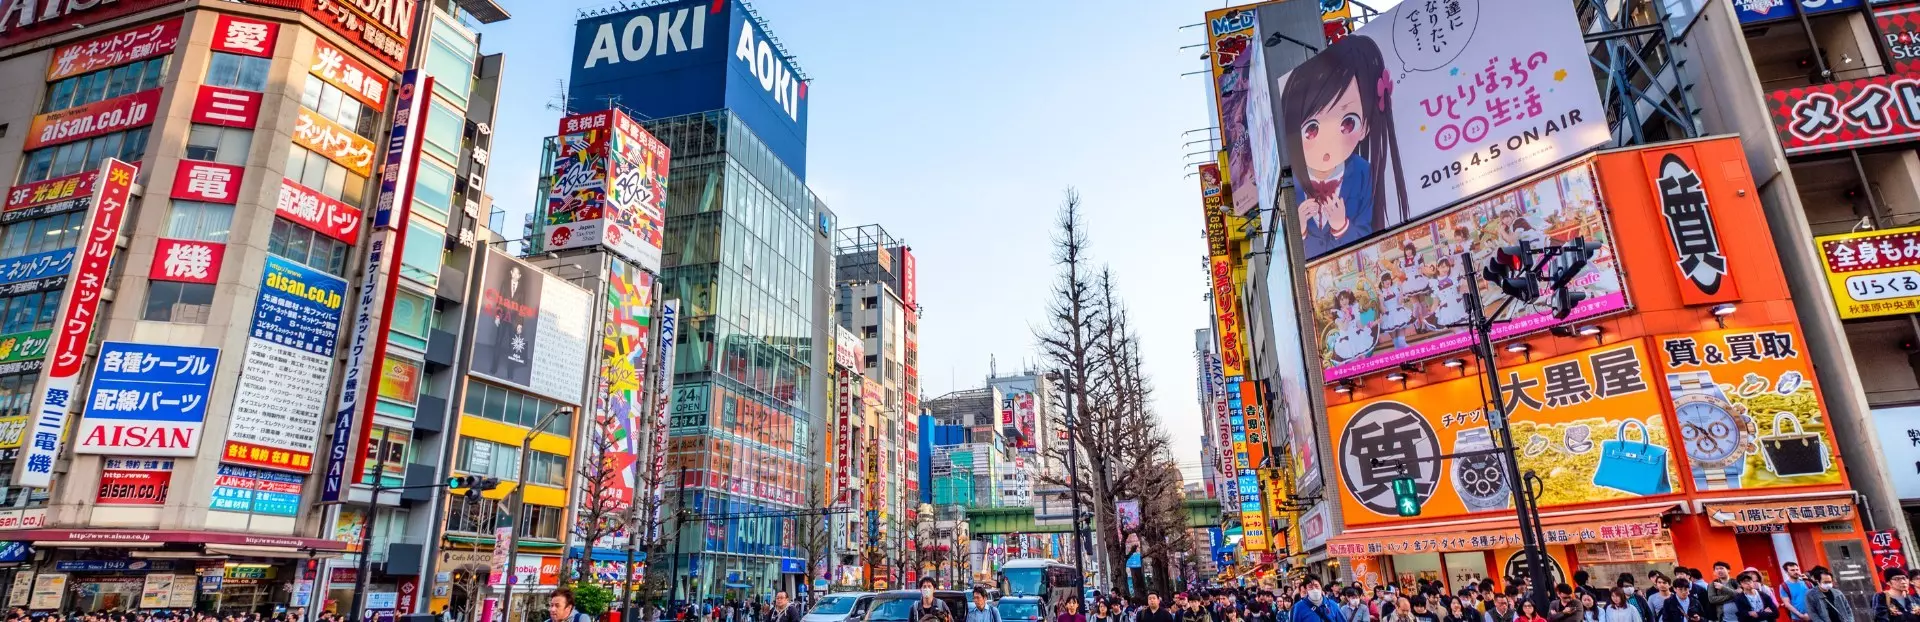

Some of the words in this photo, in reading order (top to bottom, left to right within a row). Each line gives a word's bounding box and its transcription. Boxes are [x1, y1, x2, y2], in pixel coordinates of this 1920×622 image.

[1425, 0, 1447, 52] なりたい
[1443, 0, 1463, 30] 達に
[224, 20, 268, 52] 愛
[584, 6, 706, 68] AOKI
[312, 46, 384, 104] 光通信
[736, 19, 797, 122] AOKI
[1420, 51, 1547, 120] ひとりぼっちの
[40, 101, 148, 143] aisan.co.jp
[205, 92, 249, 122] 三
[567, 114, 606, 131] 免税店
[295, 118, 373, 167] ネットワーク
[1420, 144, 1500, 189] 2019.4.5
[1506, 127, 1540, 150] ON
[1546, 109, 1583, 137] AIR
[9, 188, 31, 206] 3F
[188, 165, 231, 199] 電
[276, 184, 358, 234] 配線パーツ
[1657, 171, 1727, 278] 質
[7, 251, 74, 280] ネットワーク
[58, 167, 130, 368] 光・ケーブル・ネットワーク
[164, 243, 212, 278] 機
[266, 271, 342, 309] aisan.co.jp
[1853, 276, 1918, 296] りらくる
[663, 304, 674, 347] AKKY
[104, 351, 209, 376] 各種ケーブル
[1500, 346, 1648, 413] 大黒屋
[93, 389, 201, 412] 配線パーツ
[676, 402, 699, 412] OPEN
[28, 388, 69, 473] 愛三電機
[83, 425, 194, 448] AISAN
[1218, 399, 1229, 447] Tax-free
[1224, 449, 1233, 478] Shop
[107, 459, 120, 468] 各社
[229, 444, 247, 458] 各社
[327, 414, 349, 492] AISAN
[101, 481, 167, 502] aisan.co.jp
[69, 532, 150, 541] http://www.aisan.co.jp
[1601, 522, 1660, 538] 無料査定
[1873, 533, 1892, 546] 4F
[1329, 543, 1365, 555] 高価買取
